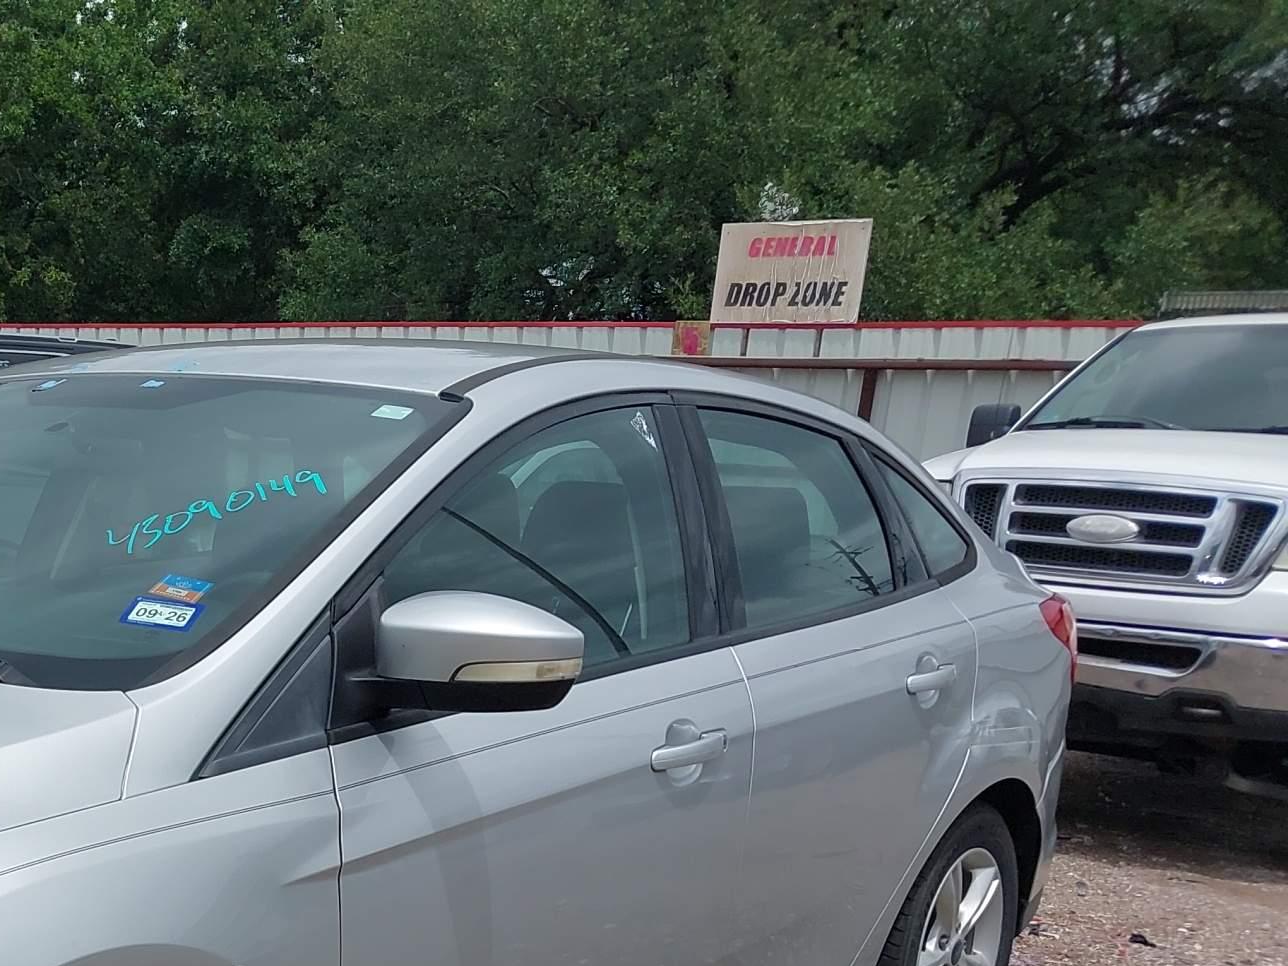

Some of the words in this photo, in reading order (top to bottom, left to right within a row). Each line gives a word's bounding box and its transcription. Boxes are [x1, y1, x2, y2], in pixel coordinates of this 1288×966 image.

[748, 235, 838, 259] GENERAL
[724, 281, 788, 308] DROP
[787, 281, 849, 308] ZONE
[135, 607, 158, 619] 09
[164, 611, 189, 623] 26
